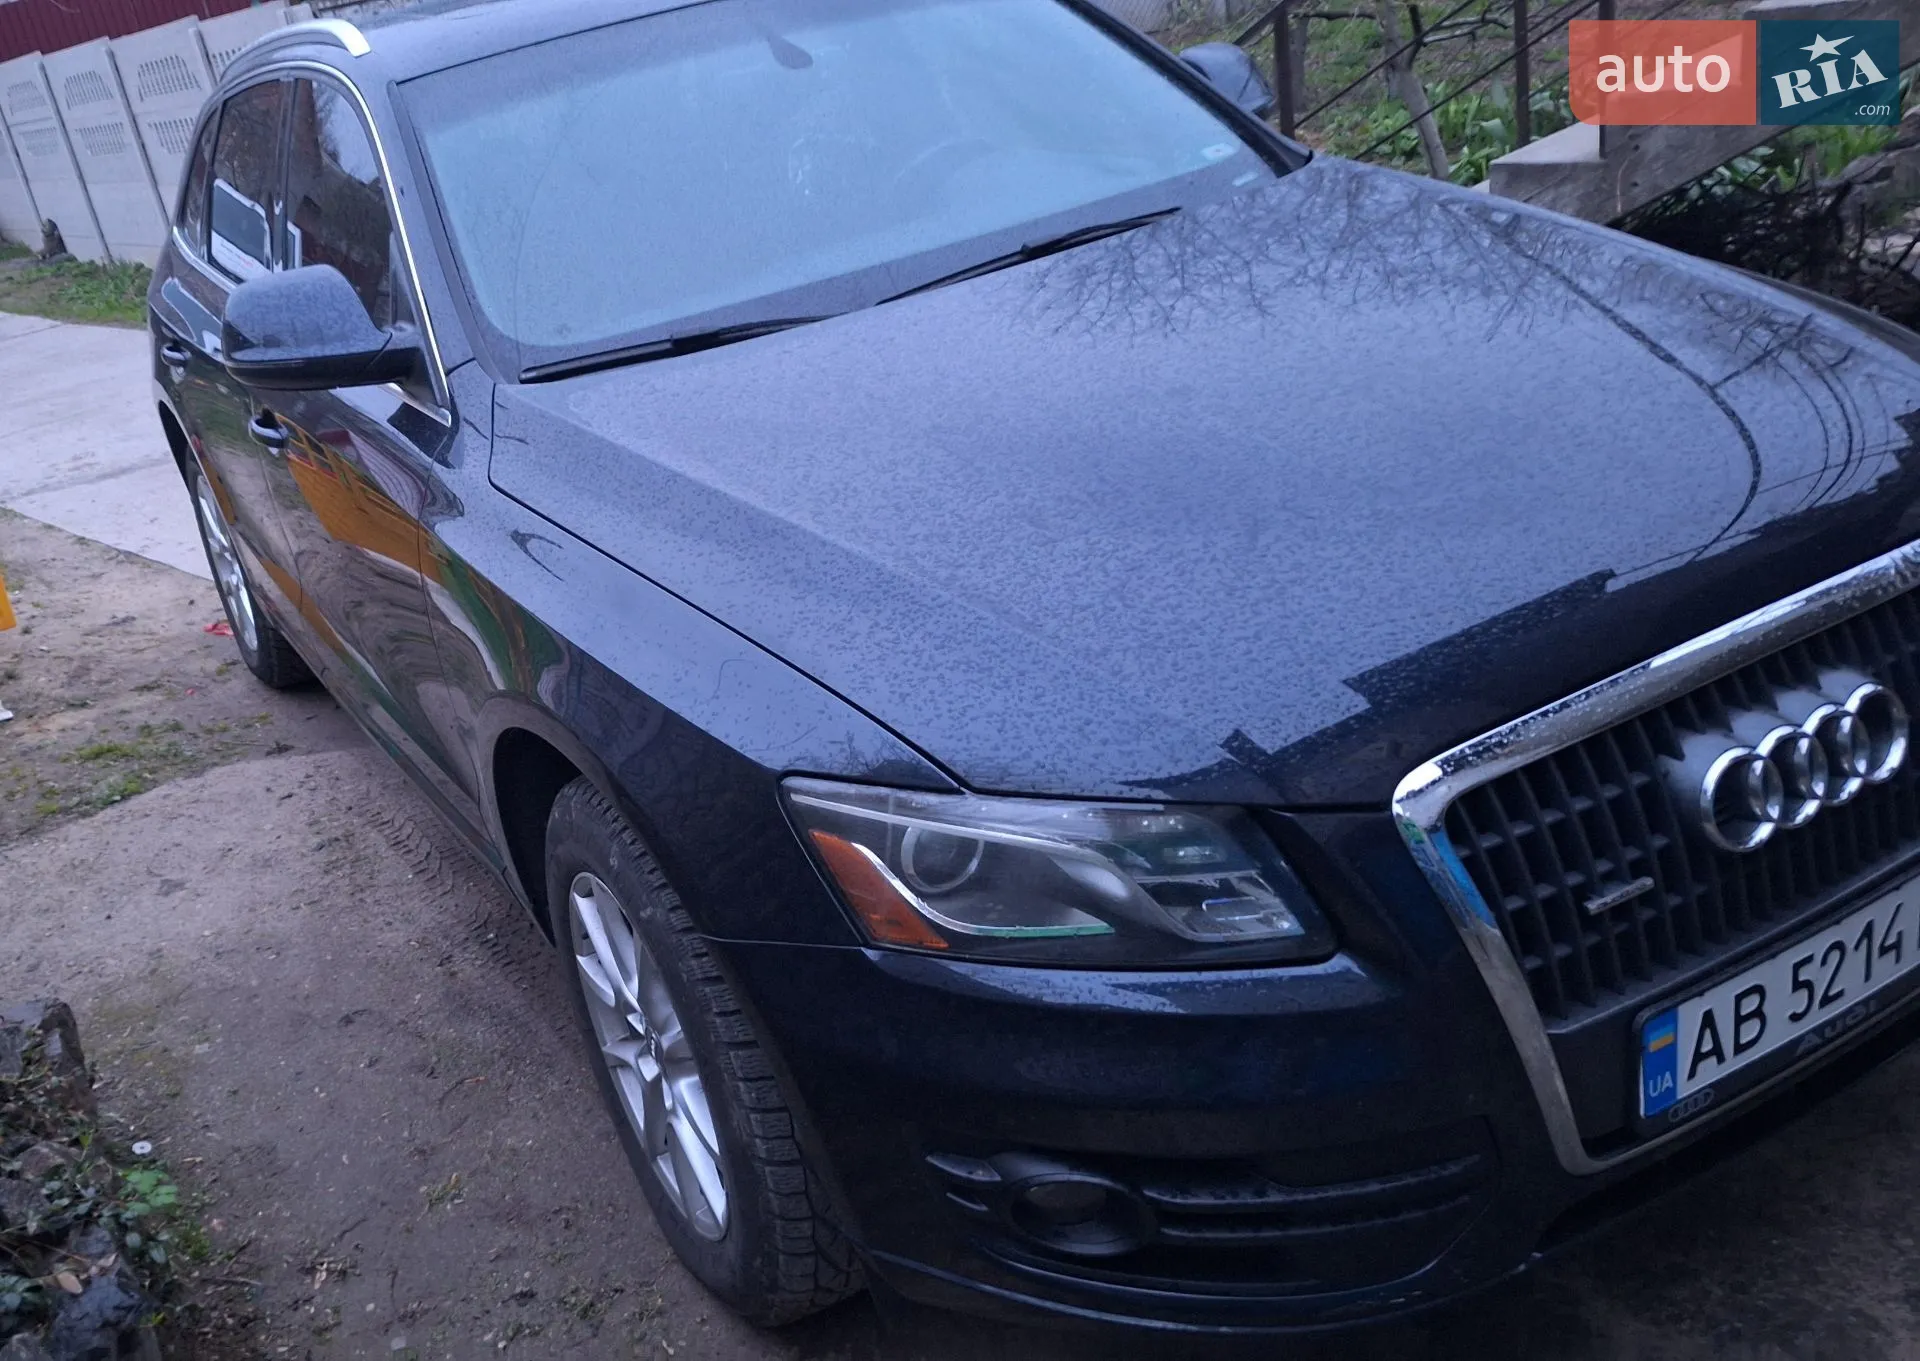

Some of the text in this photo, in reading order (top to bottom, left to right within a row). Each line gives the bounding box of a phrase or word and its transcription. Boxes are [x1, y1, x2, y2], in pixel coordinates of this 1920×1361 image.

[1686, 983, 1767, 1082] AB
[1788, 902, 1904, 1023] 5214
[1650, 1070, 1673, 1098] UA
